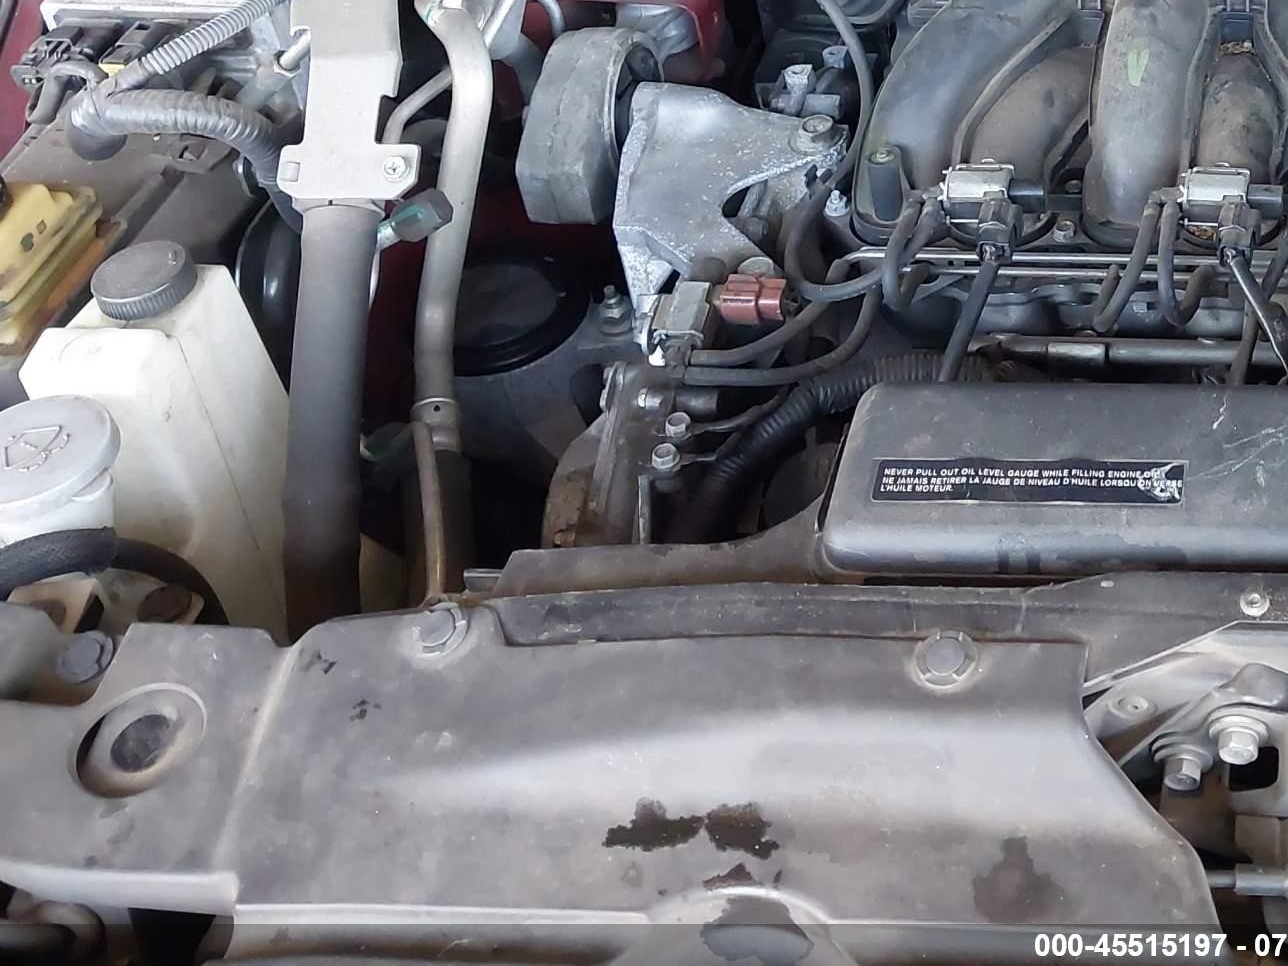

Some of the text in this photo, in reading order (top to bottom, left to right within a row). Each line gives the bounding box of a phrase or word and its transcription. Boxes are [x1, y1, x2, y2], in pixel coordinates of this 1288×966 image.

[884, 468, 914, 476] NEVER
[916, 468, 938, 476] PULL
[940, 468, 960, 476] OUT
[978, 468, 1005, 477] LEVEL
[1008, 470, 1040, 478] GAUGE
[1042, 470, 1069, 478] WHILE
[1072, 470, 1105, 478] FILLING
[896, 477, 928, 485] JAMAIS
[969, 476, 980, 484] LA
[982, 478, 1010, 486] JAUGE
[1014, 478, 1026, 486] DE
[1028, 478, 1060, 486] NIVEAU
[1062, 478, 1098, 486] D'HUILE
[880, 484, 912, 492] L'HUILE
